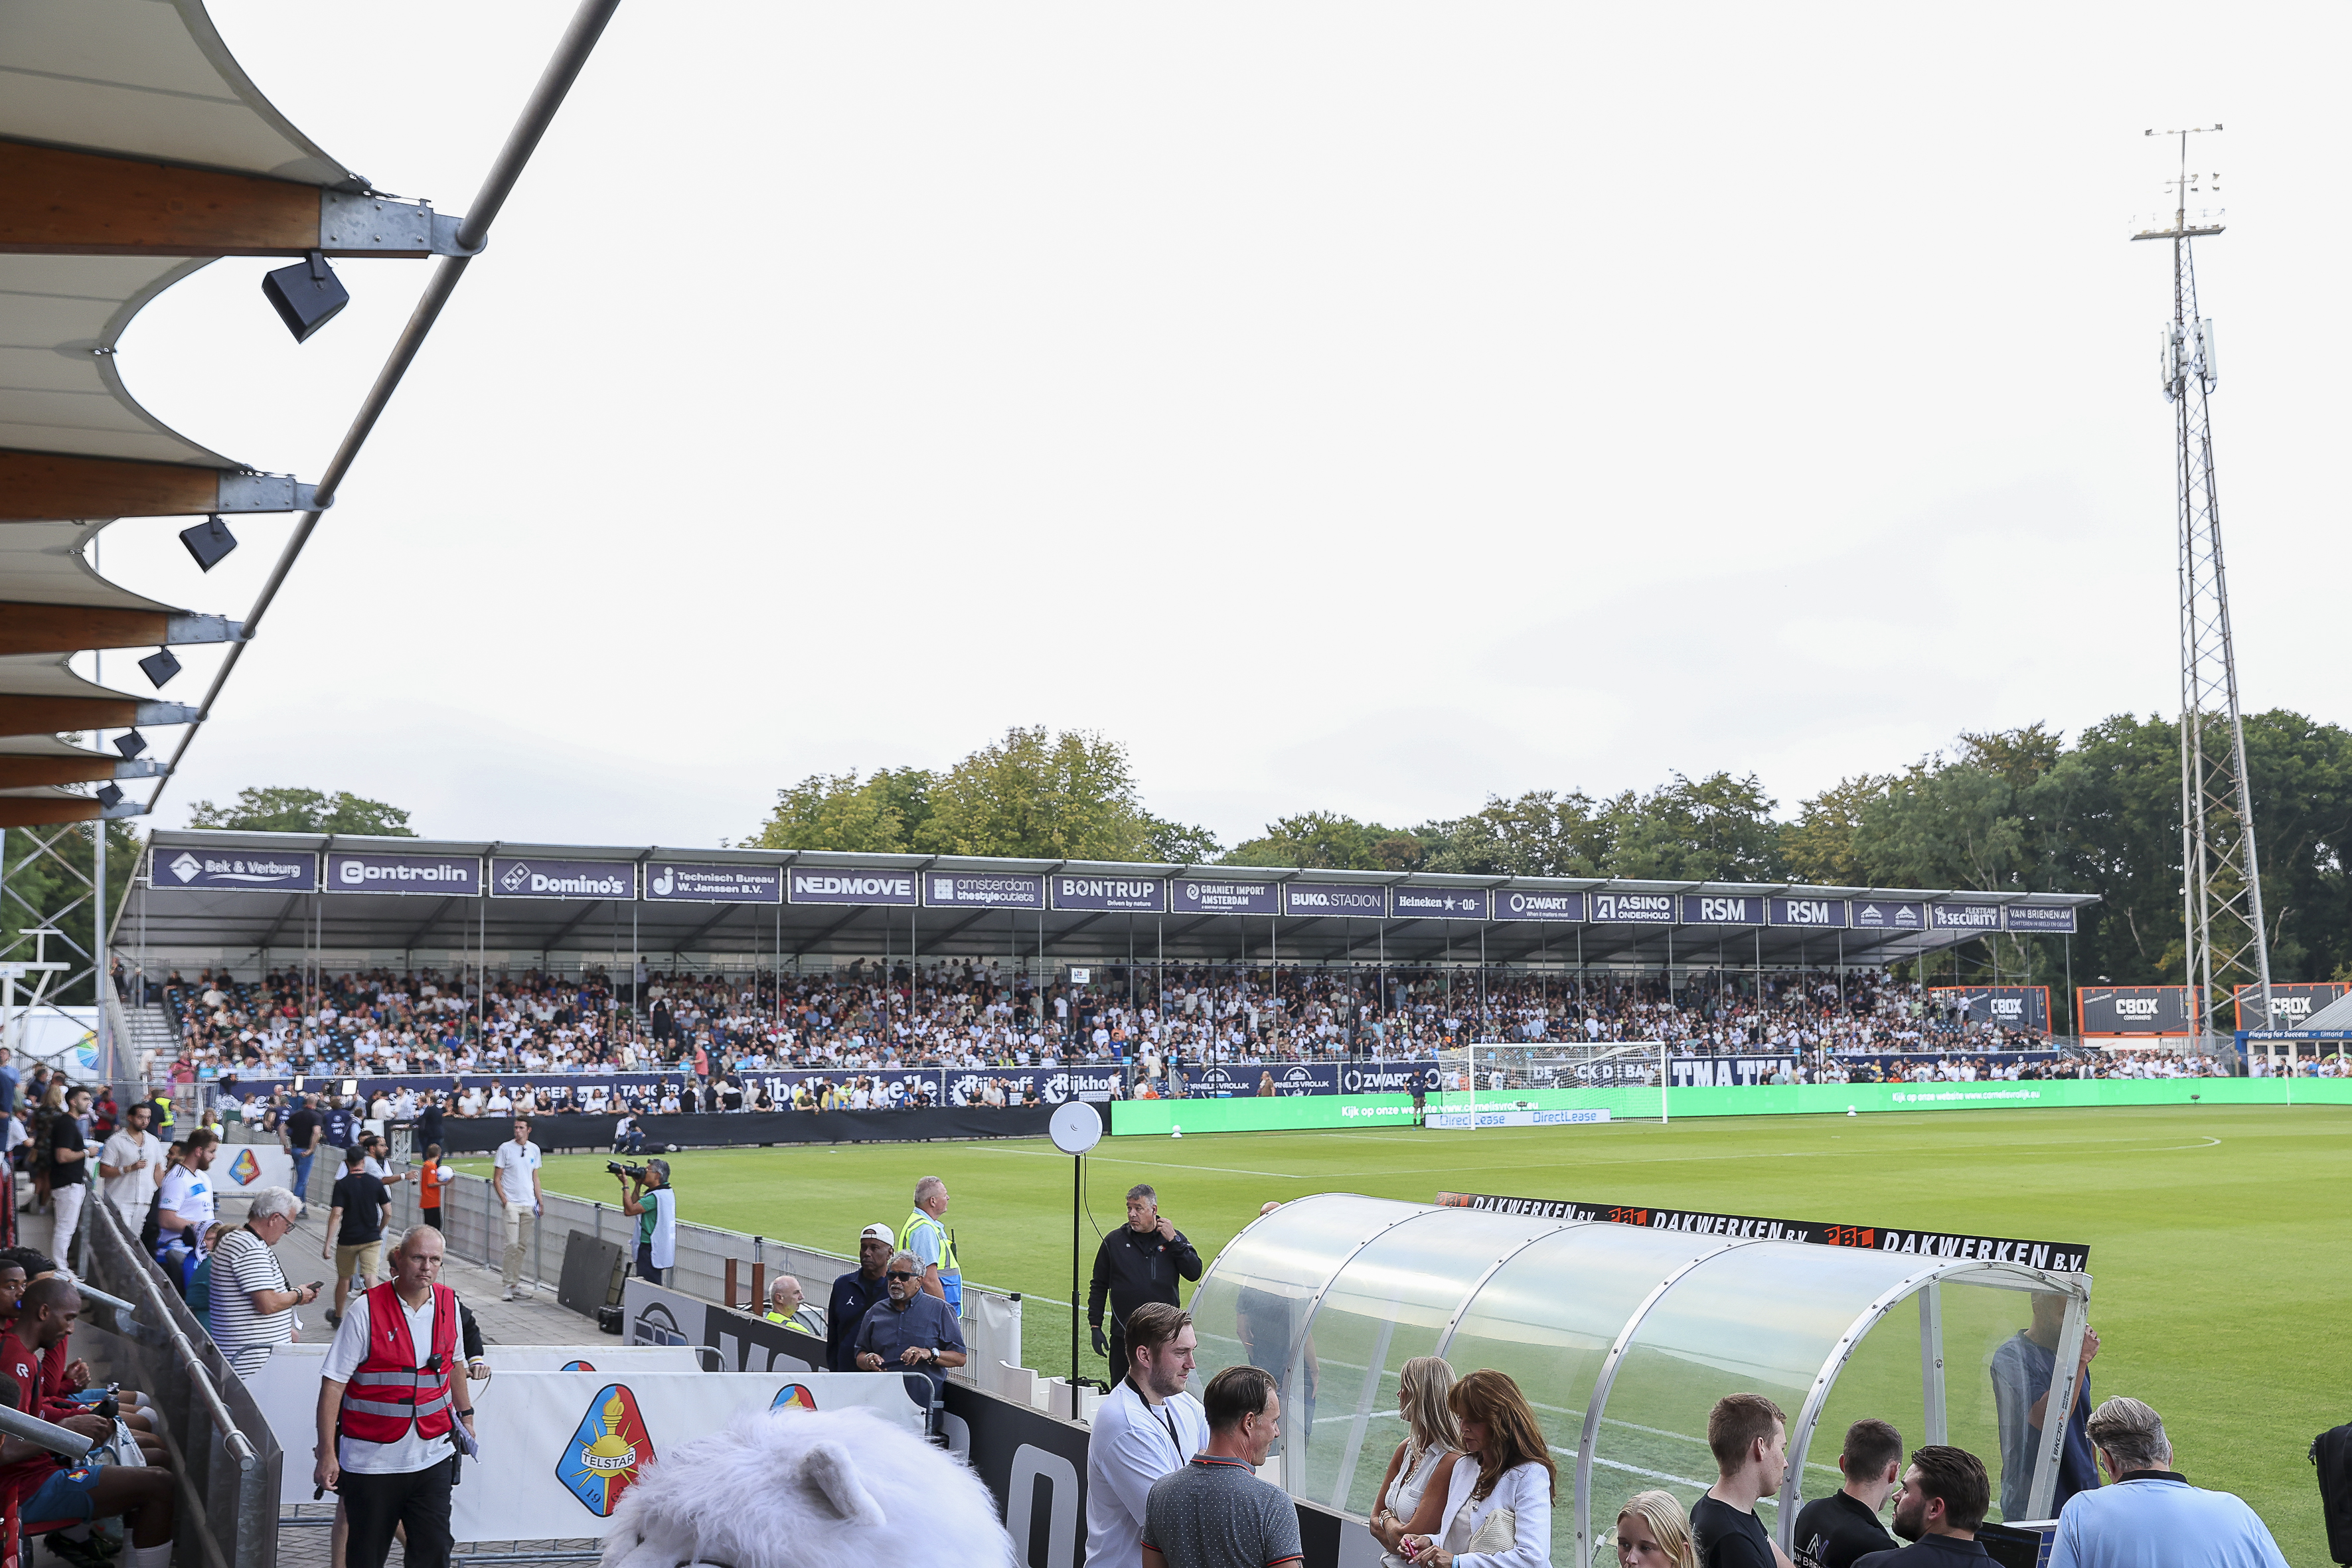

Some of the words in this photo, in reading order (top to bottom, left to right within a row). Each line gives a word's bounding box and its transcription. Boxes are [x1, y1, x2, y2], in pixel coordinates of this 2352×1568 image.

[246, 861, 301, 878] Verburg
[341, 860, 468, 884] Controlin
[531, 873, 623, 895] Domino's
[677, 871, 734, 883] Technisch
[736, 874, 775, 884] Bureau
[677, 882, 692, 893] W.
[694, 883, 740, 894] Janssen
[742, 884, 763, 894] B.V.
[796, 876, 911, 896] NEDMOVE
[957, 878, 1034, 892] amsterdam
[1062, 880, 1155, 898] BONTRUP
[1201, 885, 1235, 895] GRANIET
[1236, 886, 1265, 896] IMPORT
[957, 890, 1035, 903] thestyleoutlets
[1202, 895, 1249, 905] AMSTERDAM
[1330, 894, 1381, 907] STADION
[1399, 896, 1443, 909] Heineken
[1526, 897, 1569, 910] ZWART
[1618, 896, 1671, 910] ASINO
[1618, 910, 1671, 920] ONDERHOUD
[1700, 898, 1746, 921] RSM
[1786, 900, 1830, 923] RSM
[2009, 909, 2026, 918] VAN
[2027, 909, 2059, 919] BRIENEN
[1947, 913, 1998, 926] SECURITY
[1990, 998, 2023, 1014] CBOX
[2115, 998, 2159, 1014] CBOX
[2270, 997, 2313, 1014] CBOX
[2248, 1030, 2272, 1040] Playing
[963, 1074, 1034, 1093] Rijoff
[1056, 1073, 1122, 1095] Rijkho
[1363, 1073, 1413, 1087] ZWART
[1892, 1092, 1906, 1103] Kijk
[1906, 1093, 1917, 1103] op
[1936, 1091, 1964, 1101] website
[1342, 1106, 1360, 1119] Kijk
[1361, 1108, 1375, 1118] op
[1401, 1105, 1438, 1115] wesite
[1440, 1115, 1505, 1126] Directease
[1533, 1111, 1597, 1123] DirectLease
[1472, 1196, 1577, 1220] DAKWERKEN
[1652, 1212, 1784, 1241] DAKWERKEN
[1883, 1231, 2050, 1269] DAKWERKEN
[2053, 1253, 2083, 1272] B.V.
[2053, 1422, 2063, 1456] SKOR
[583, 1452, 634, 1468] TELSTAR
[586, 1488, 601, 1503] 19
